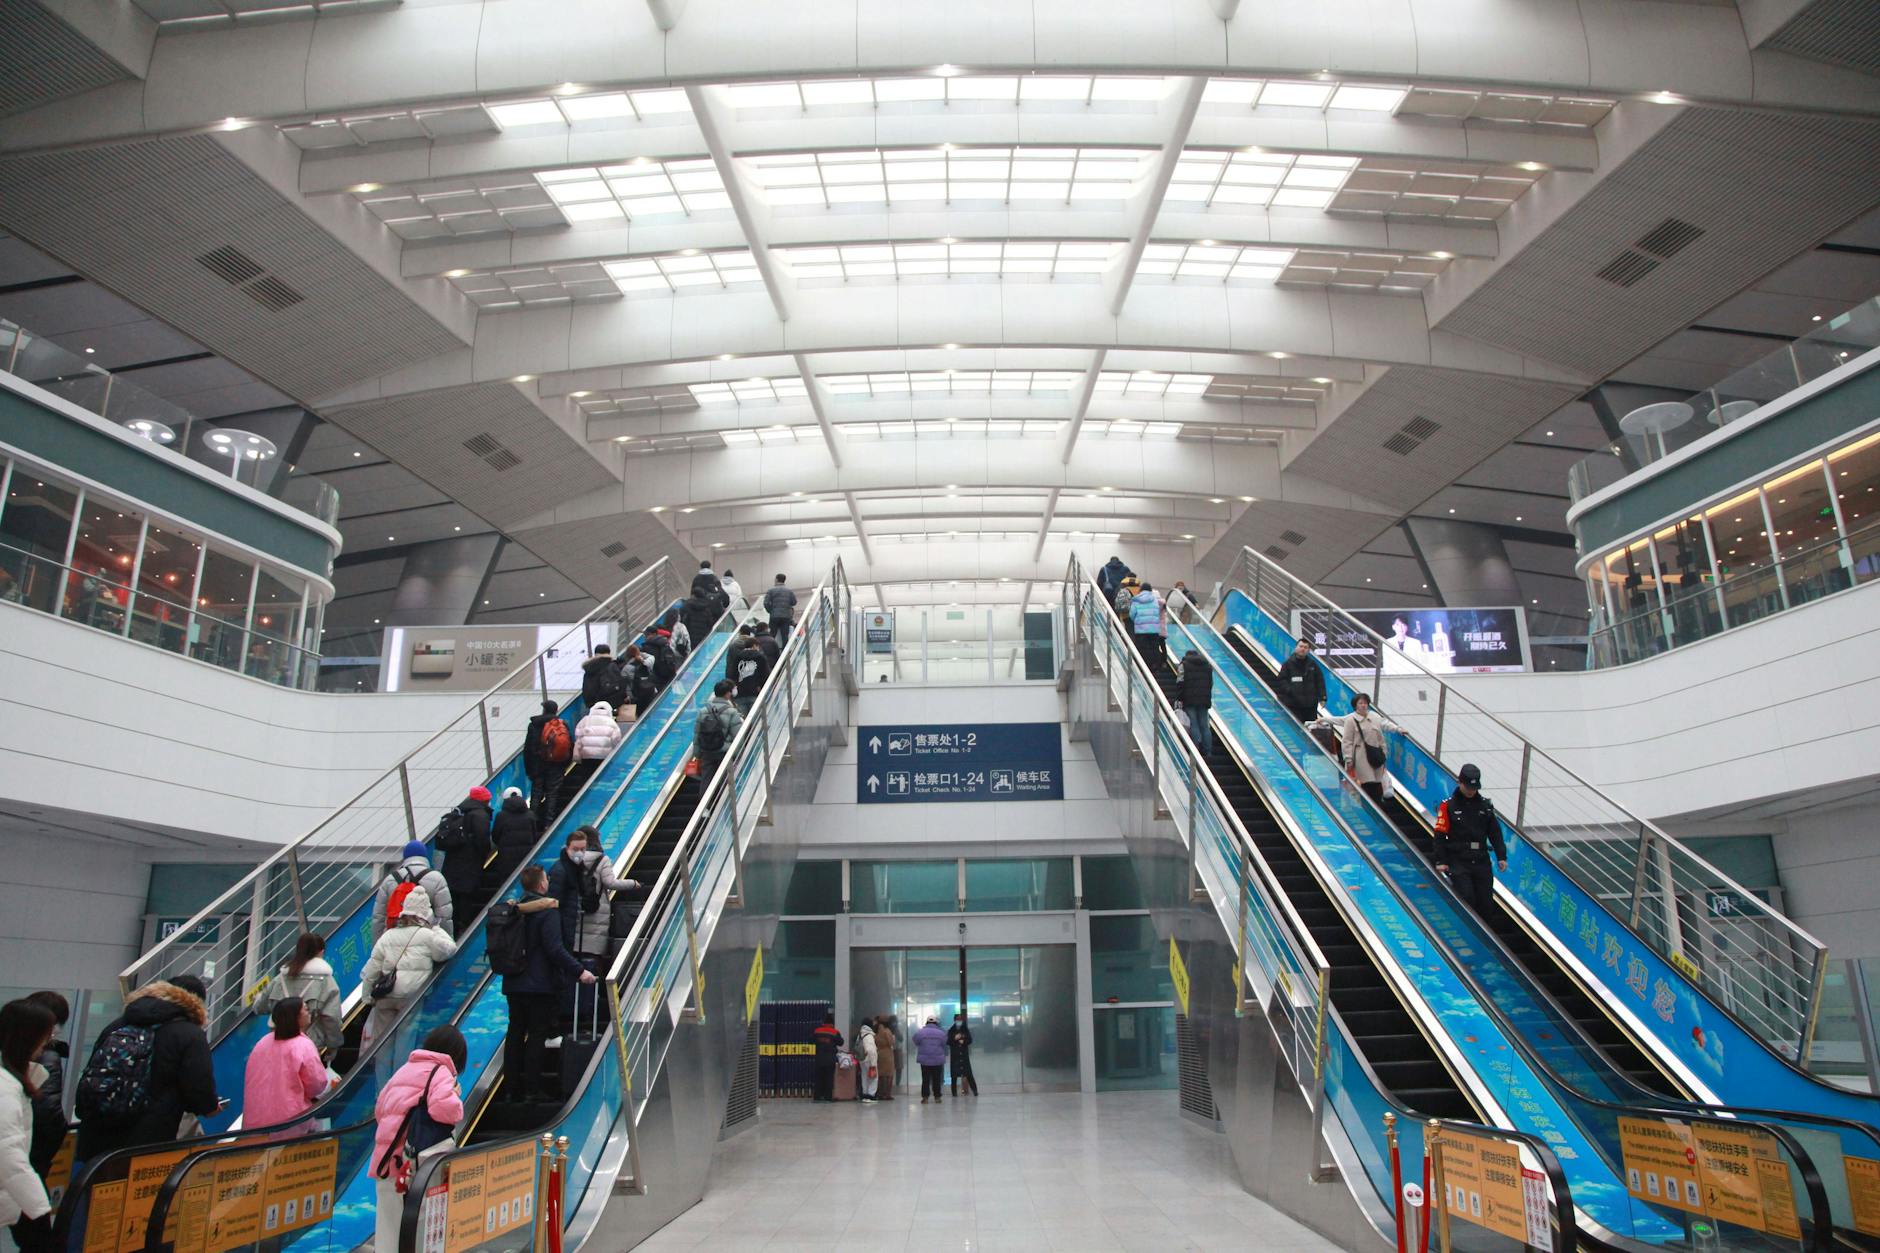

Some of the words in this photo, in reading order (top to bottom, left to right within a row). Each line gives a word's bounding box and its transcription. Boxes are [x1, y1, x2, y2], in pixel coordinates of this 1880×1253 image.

[465, 652, 509, 666] 小罐茶
[914, 732, 977, 747] 售票处1-2
[914, 772, 985, 786] 检票口1-24
[1016, 771, 1051, 783] 候车区
[1520, 857, 1675, 1024] 北京南站欢迎您
